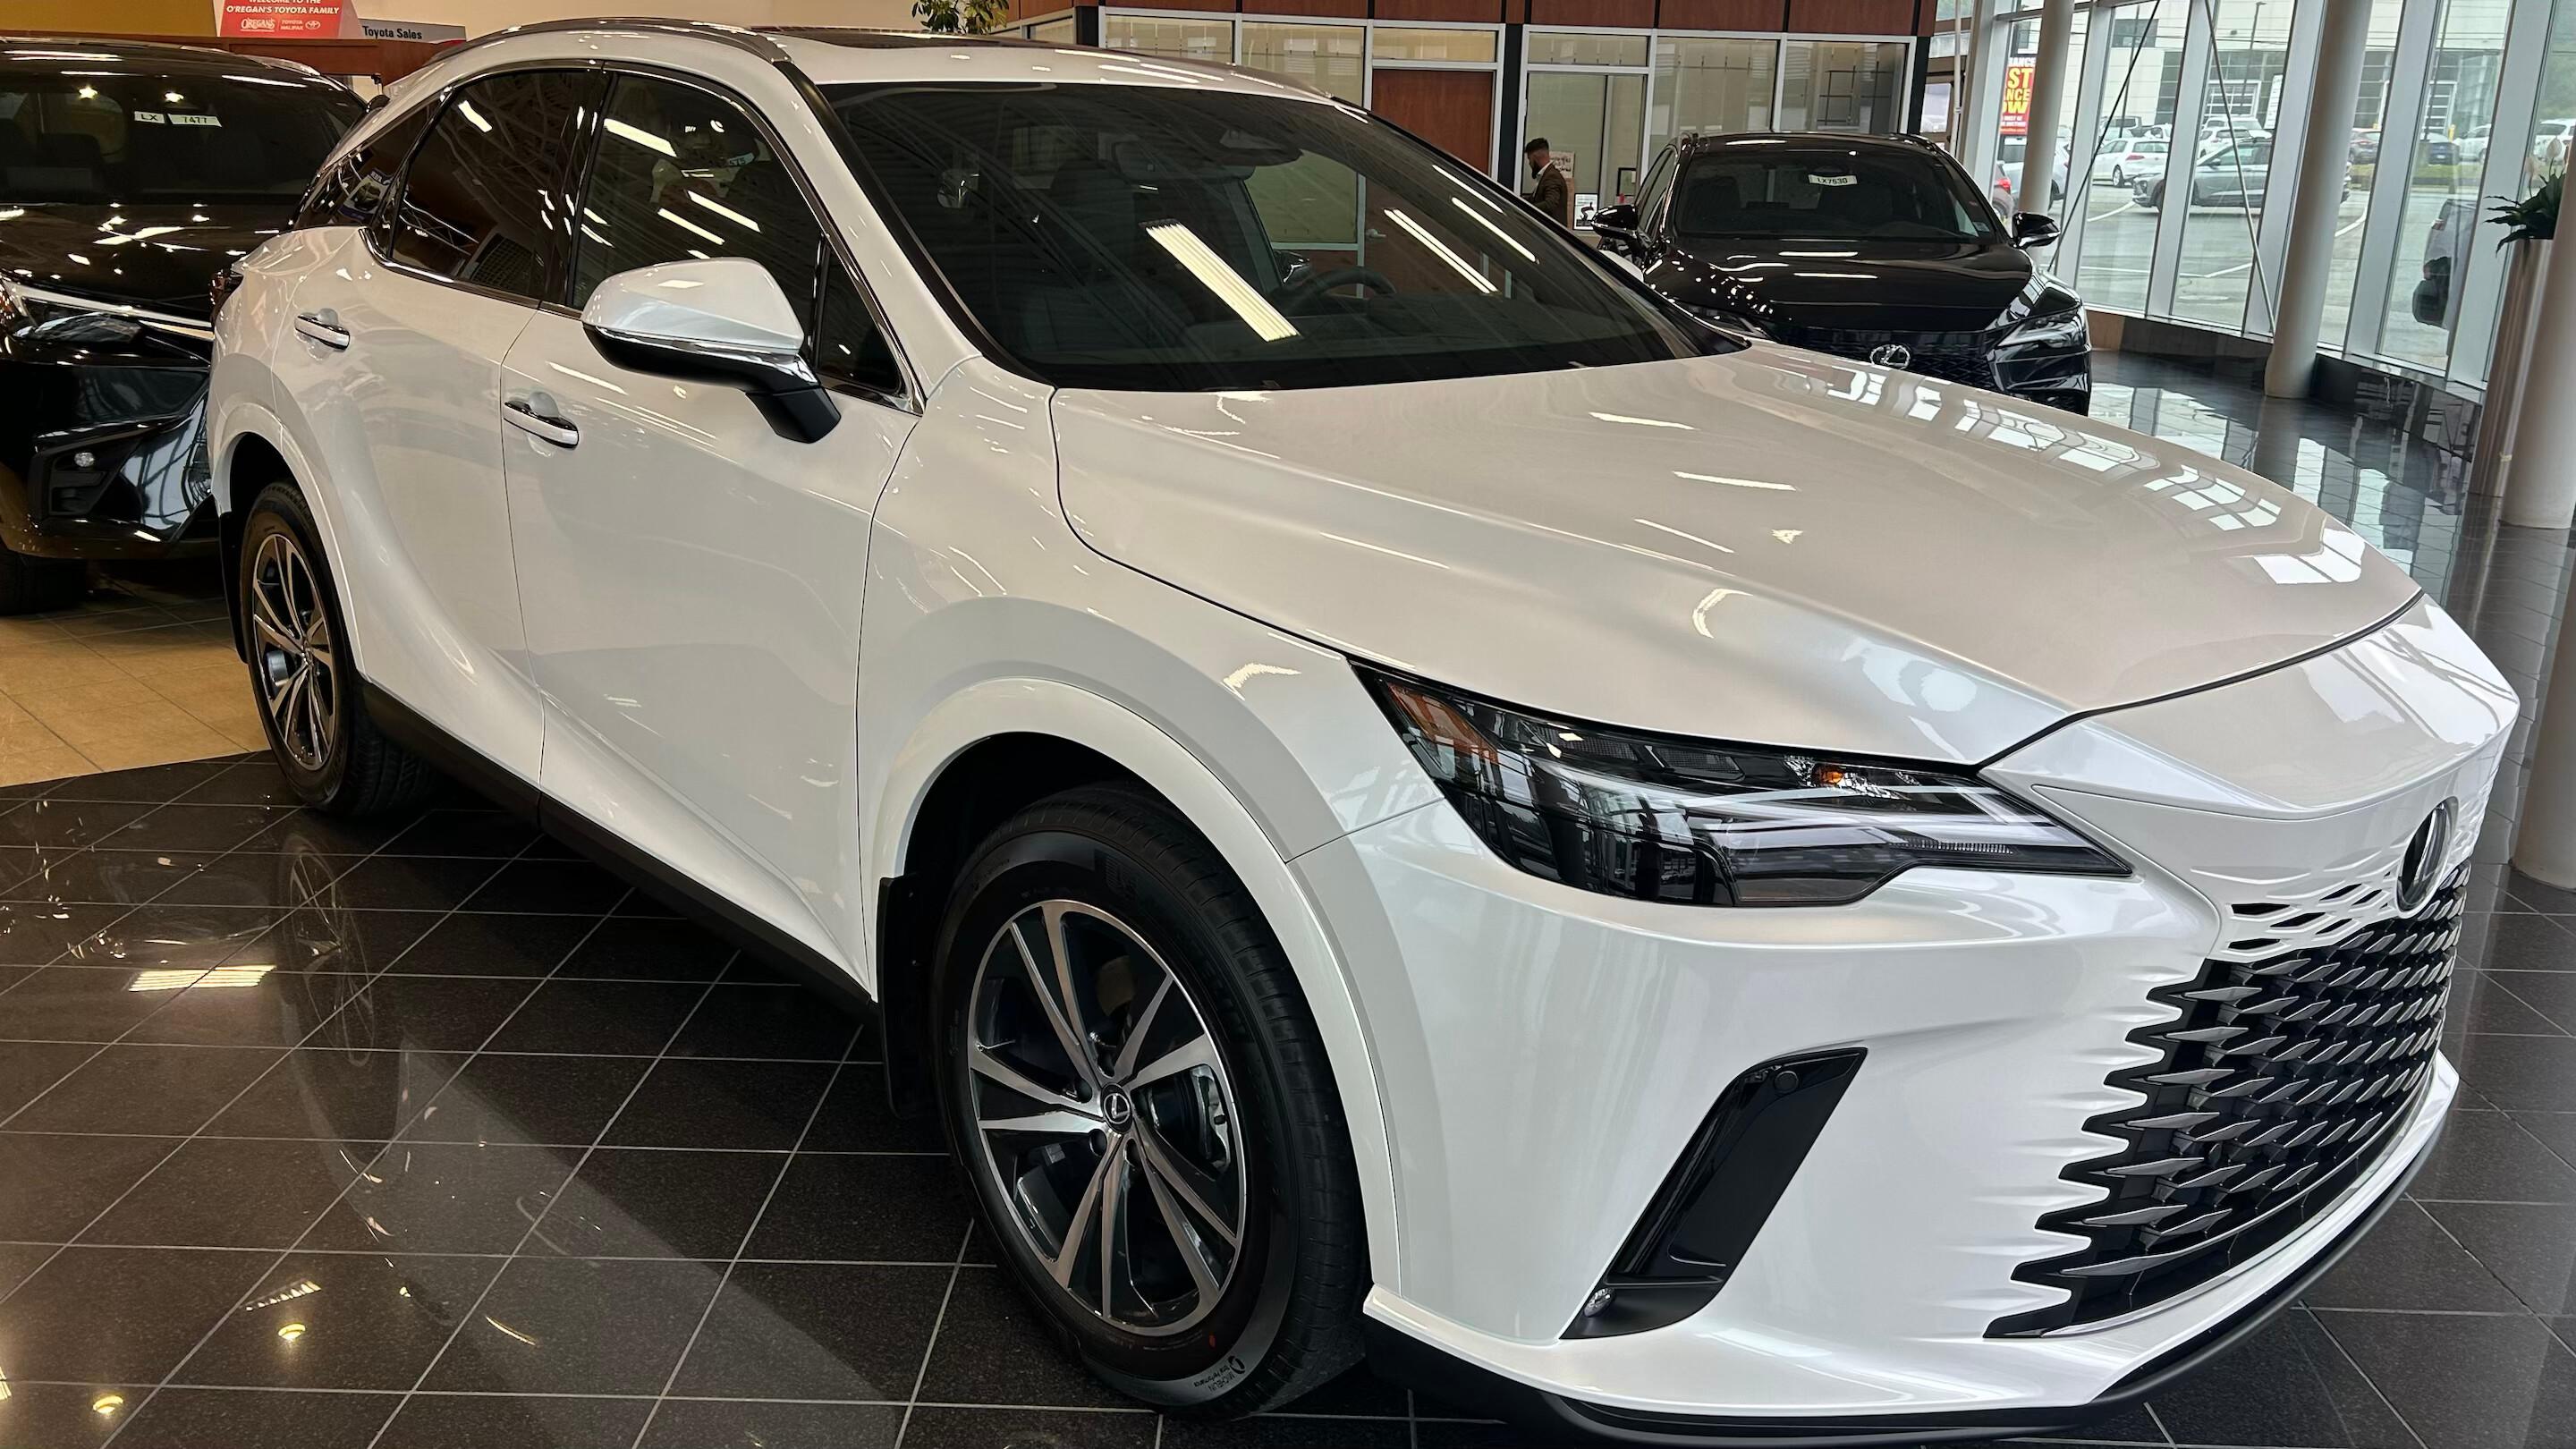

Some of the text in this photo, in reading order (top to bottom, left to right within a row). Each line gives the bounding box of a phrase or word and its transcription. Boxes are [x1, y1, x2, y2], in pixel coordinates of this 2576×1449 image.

[226, 5, 273, 13] O'REGAN'S
[362, 25, 422, 39] Toyota Sales
[2004, 88, 2030, 101] NCE
[141, 114, 158, 122] LX
